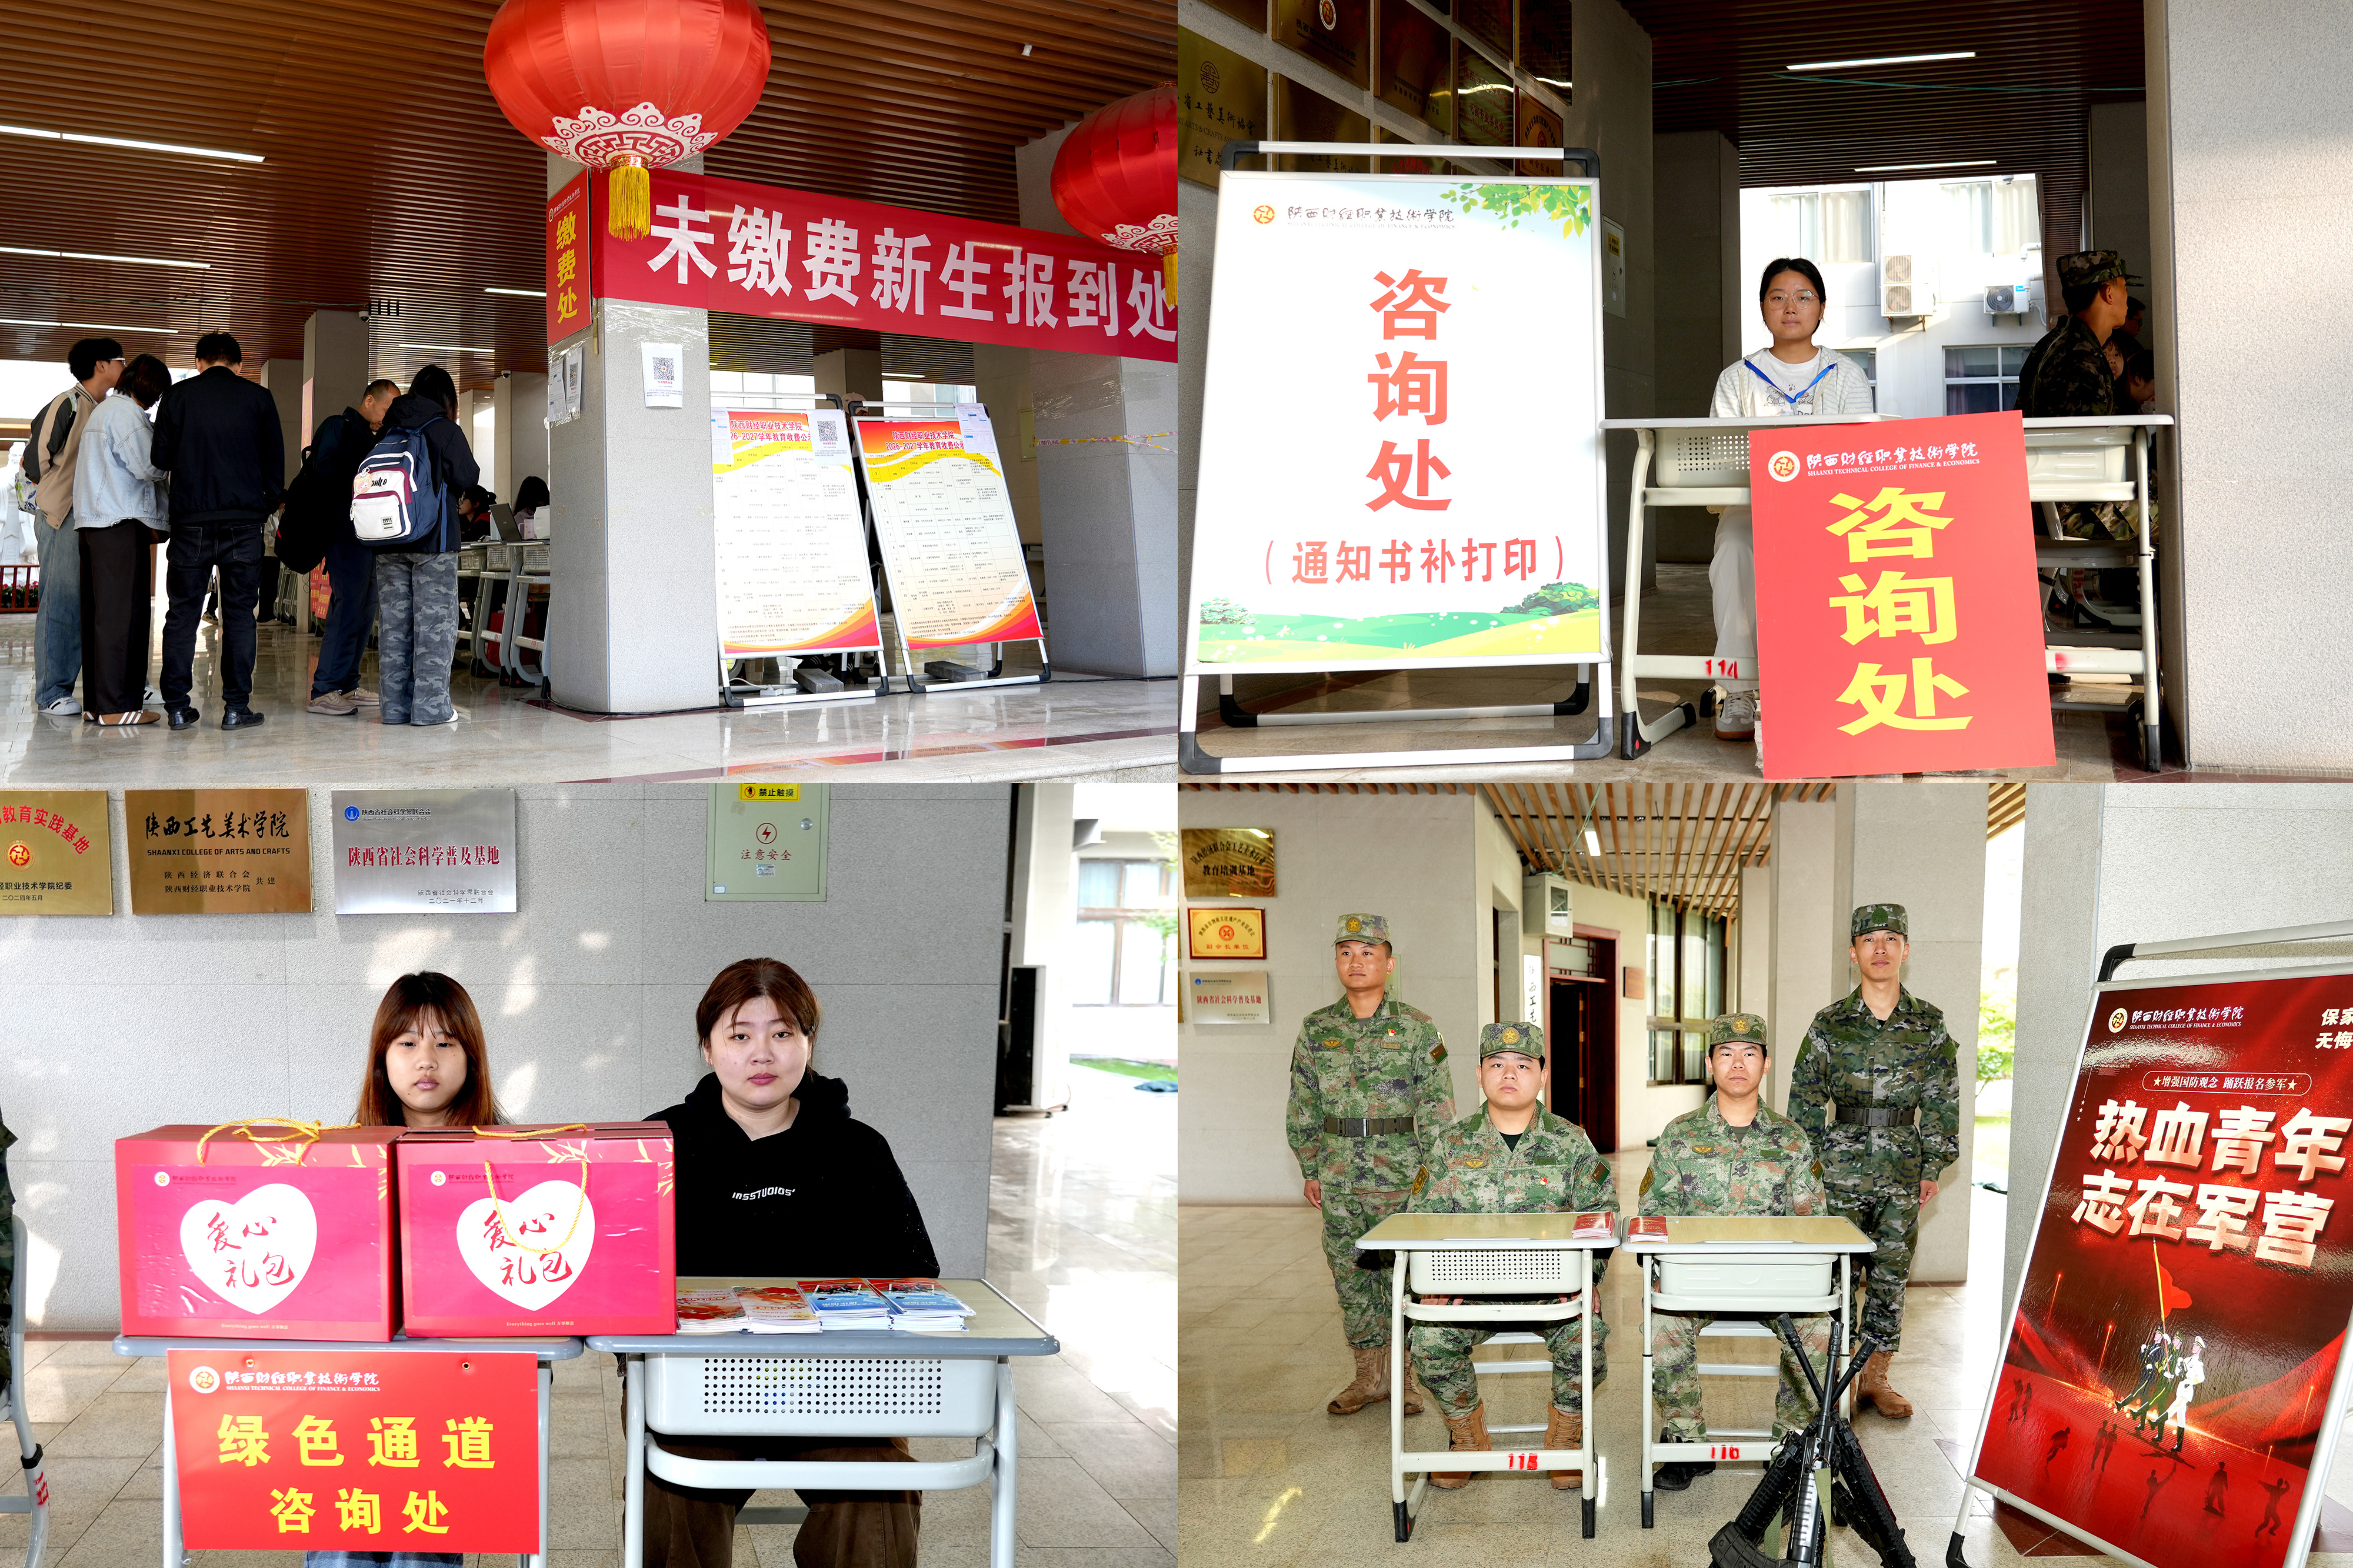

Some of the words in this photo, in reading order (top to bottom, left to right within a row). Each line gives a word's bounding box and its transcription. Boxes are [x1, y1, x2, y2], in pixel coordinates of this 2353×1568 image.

[1177, 93, 1256, 136] 省工藝美術協會
[1185, 120, 1198, 130] ARTS
[1204, 128, 1224, 141] CRAFTS
[556, 211, 578, 324] 缴费处
[1365, 268, 1452, 513] 咨询处
[731, 420, 803, 431] 陕西财经职业技术学院
[892, 431, 955, 441] 陕西财经职业技术学院
[1943, 459, 1980, 467] ECONOMICS
[1825, 487, 1974, 736] 咨询处
[1705, 659, 1738, 679] 114
[759, 788, 794, 797] 禁止触摸
[0, 805, 90, 855] 教育实践基地
[145, 810, 289, 840] 陕西工艺美术学院
[348, 845, 500, 867] 陕西省社会科学普及基地
[741, 848, 792, 860] 注意安全
[164, 870, 250, 879] 陕西经济联合会
[1203, 864, 1255, 876] 教育培训基地
[165, 884, 251, 893] 陕西财经职业技术学院
[1197, 995, 1262, 1004] 陕西省社会科学普及基地
[2321, 1008, 2353, 1026] 保家
[2315, 1032, 2353, 1050] 无悔
[2162, 1075, 2219, 1089] 增强国防观念
[2222, 1076, 2288, 1091] 踊跃报名参军
[2089, 1099, 2353, 1182] 热血青年
[2070, 1168, 2335, 1269] 志在军营
[206, 1210, 276, 1253] 爱心
[224, 1252, 295, 1288] 礼包
[500, 1248, 573, 1286] 礼包
[217, 1414, 496, 1469] 绿色通道
[1711, 1444, 1739, 1460] 116
[269, 1487, 450, 1534] 咨询处
